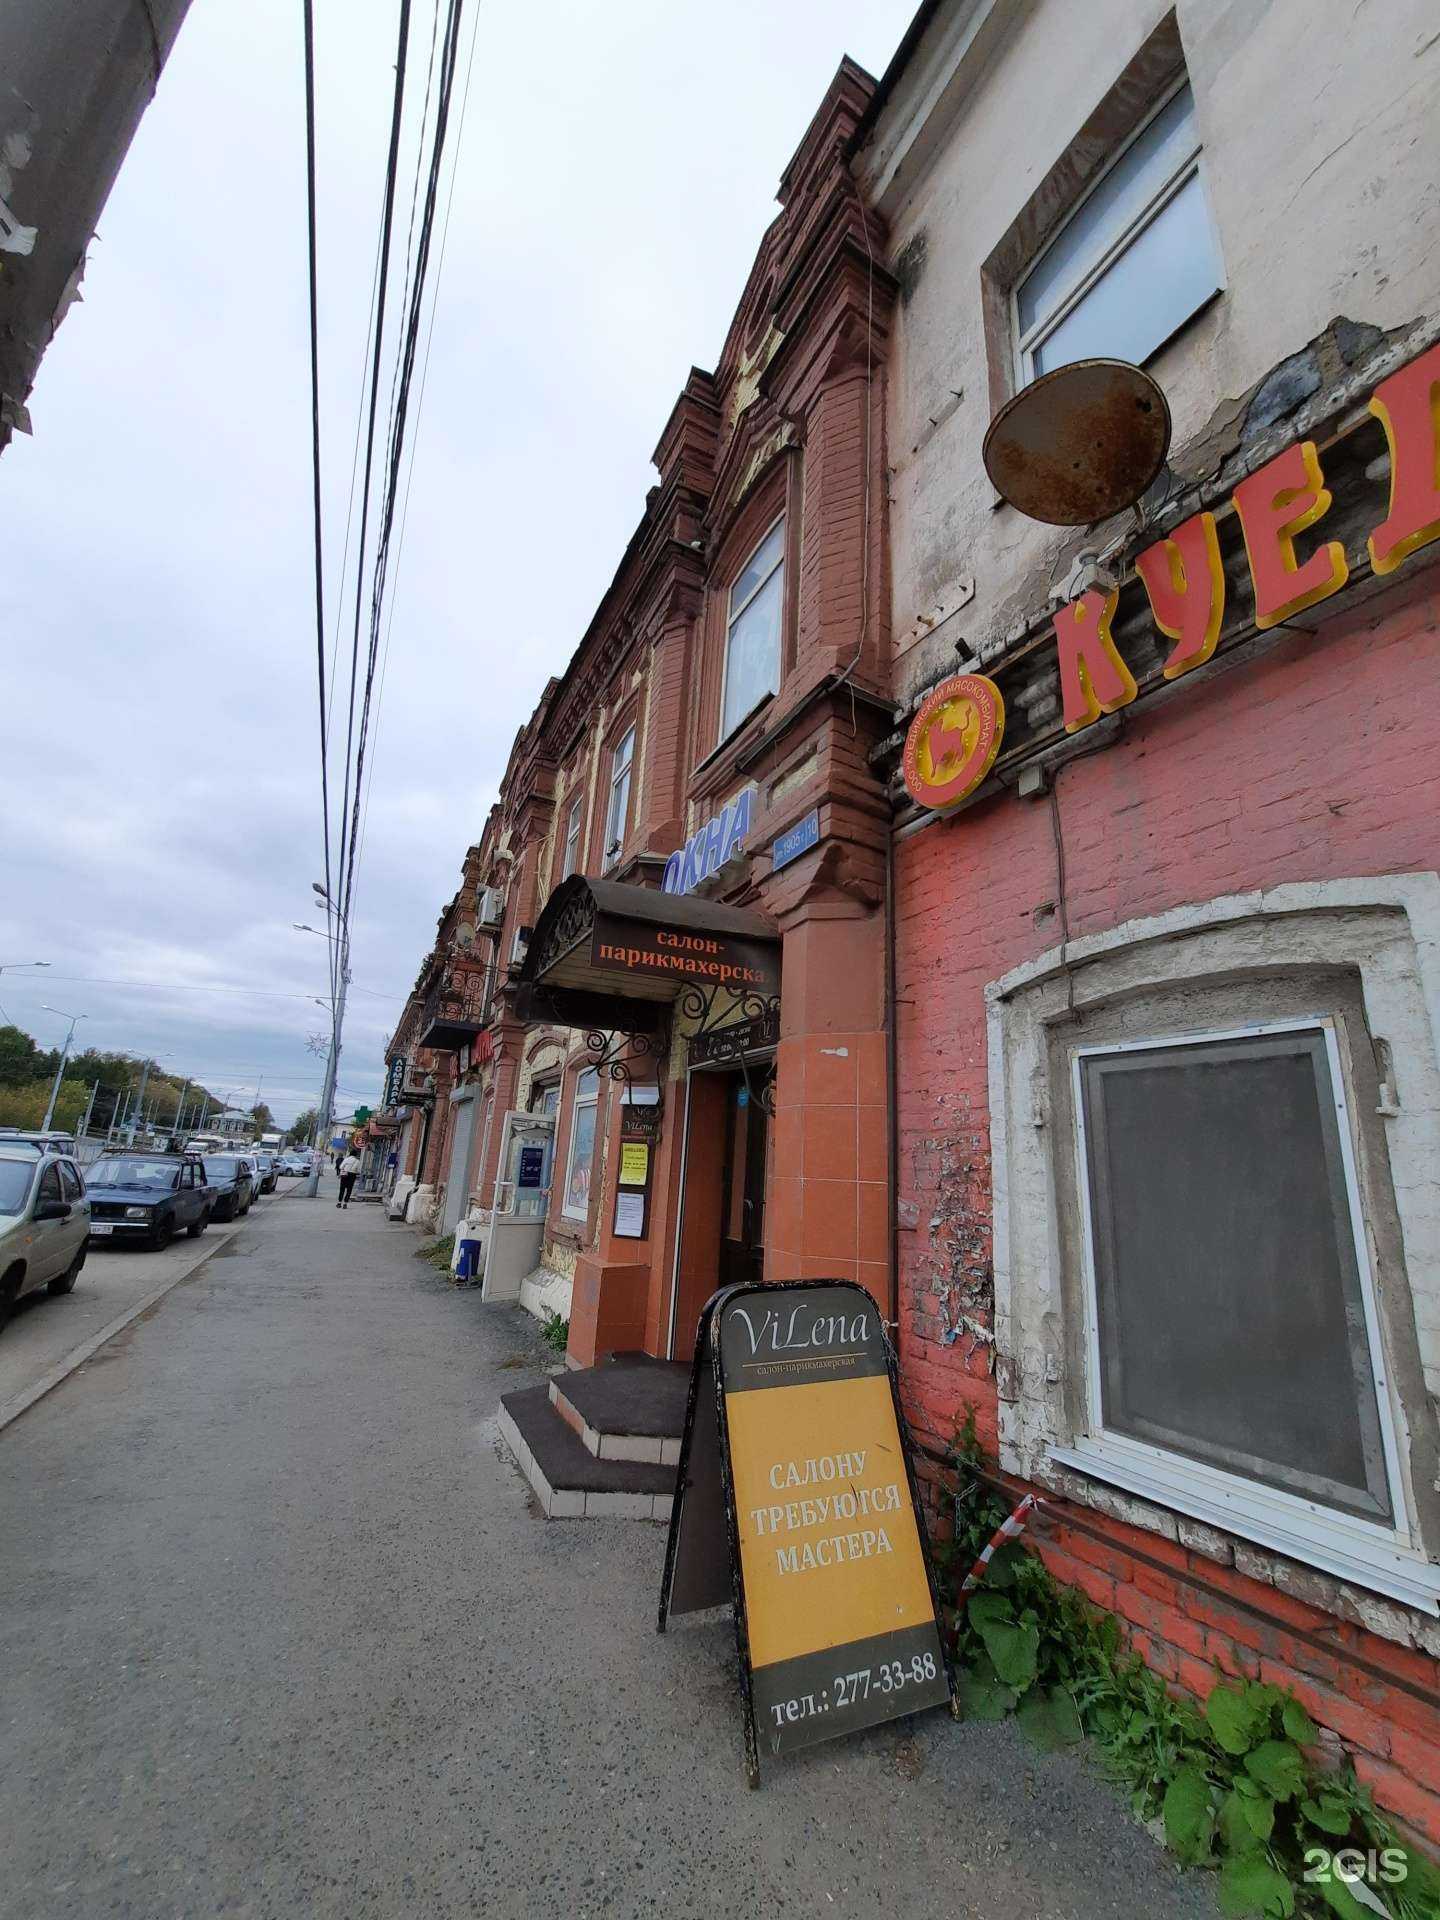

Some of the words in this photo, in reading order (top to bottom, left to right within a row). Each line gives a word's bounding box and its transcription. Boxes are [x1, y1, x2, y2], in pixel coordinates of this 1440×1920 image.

[660, 788, 751, 896] ОКНА
[656, 931, 725, 954] салон-
[729, 1304, 871, 1355] ViLena
[769, 1450, 867, 1490] САЛОНУ
[751, 1485, 901, 1536] ТРЕБУЮТСЯ
[776, 1528, 893, 1576] МАСТЕРА
[771, 1690, 830, 1726] тел.:
[834, 1652, 937, 1708] 277-33-88
